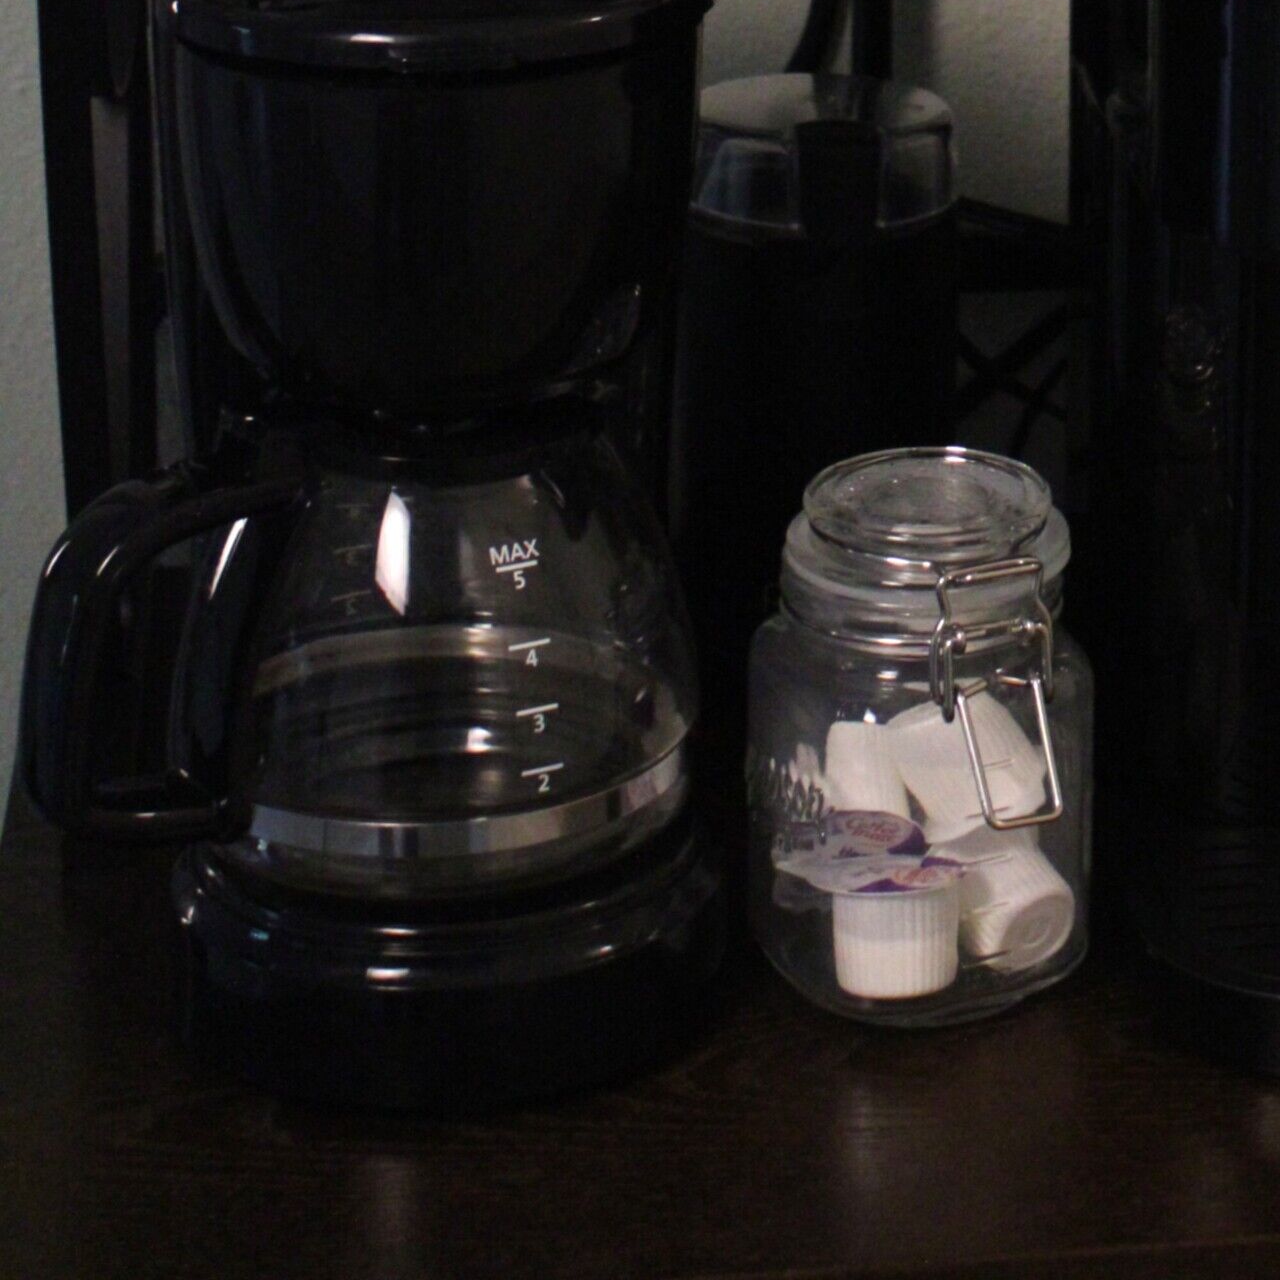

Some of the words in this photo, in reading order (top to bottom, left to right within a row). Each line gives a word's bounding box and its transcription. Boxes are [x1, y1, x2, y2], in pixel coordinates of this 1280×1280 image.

[489, 538, 540, 567] MAX
[512, 570, 527, 590] 5
[525, 648, 539, 668] 4
[534, 713, 546, 734] 3
[538, 773, 552, 793] 2
